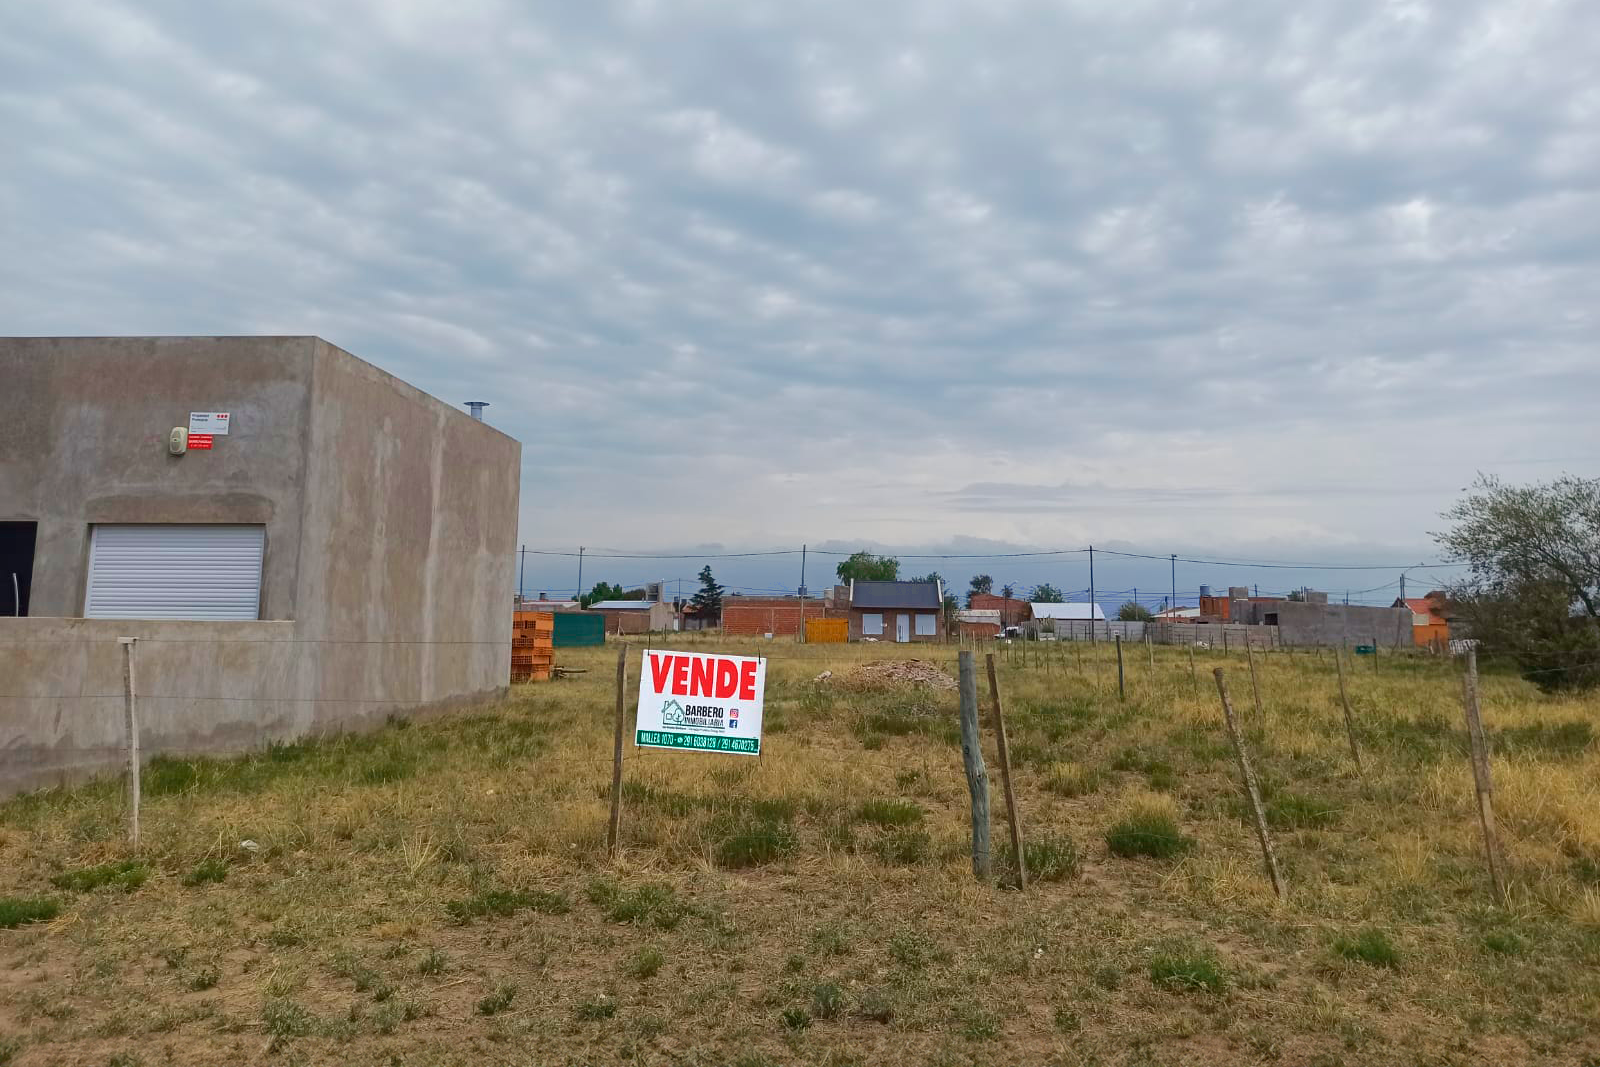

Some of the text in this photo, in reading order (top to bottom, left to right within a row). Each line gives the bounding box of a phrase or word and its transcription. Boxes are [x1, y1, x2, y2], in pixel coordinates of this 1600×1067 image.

[649, 654, 757, 700] VENDE
[685, 705, 724, 718] BARBERO
[684, 736, 692, 746] 291
[722, 739, 730, 749] 291
